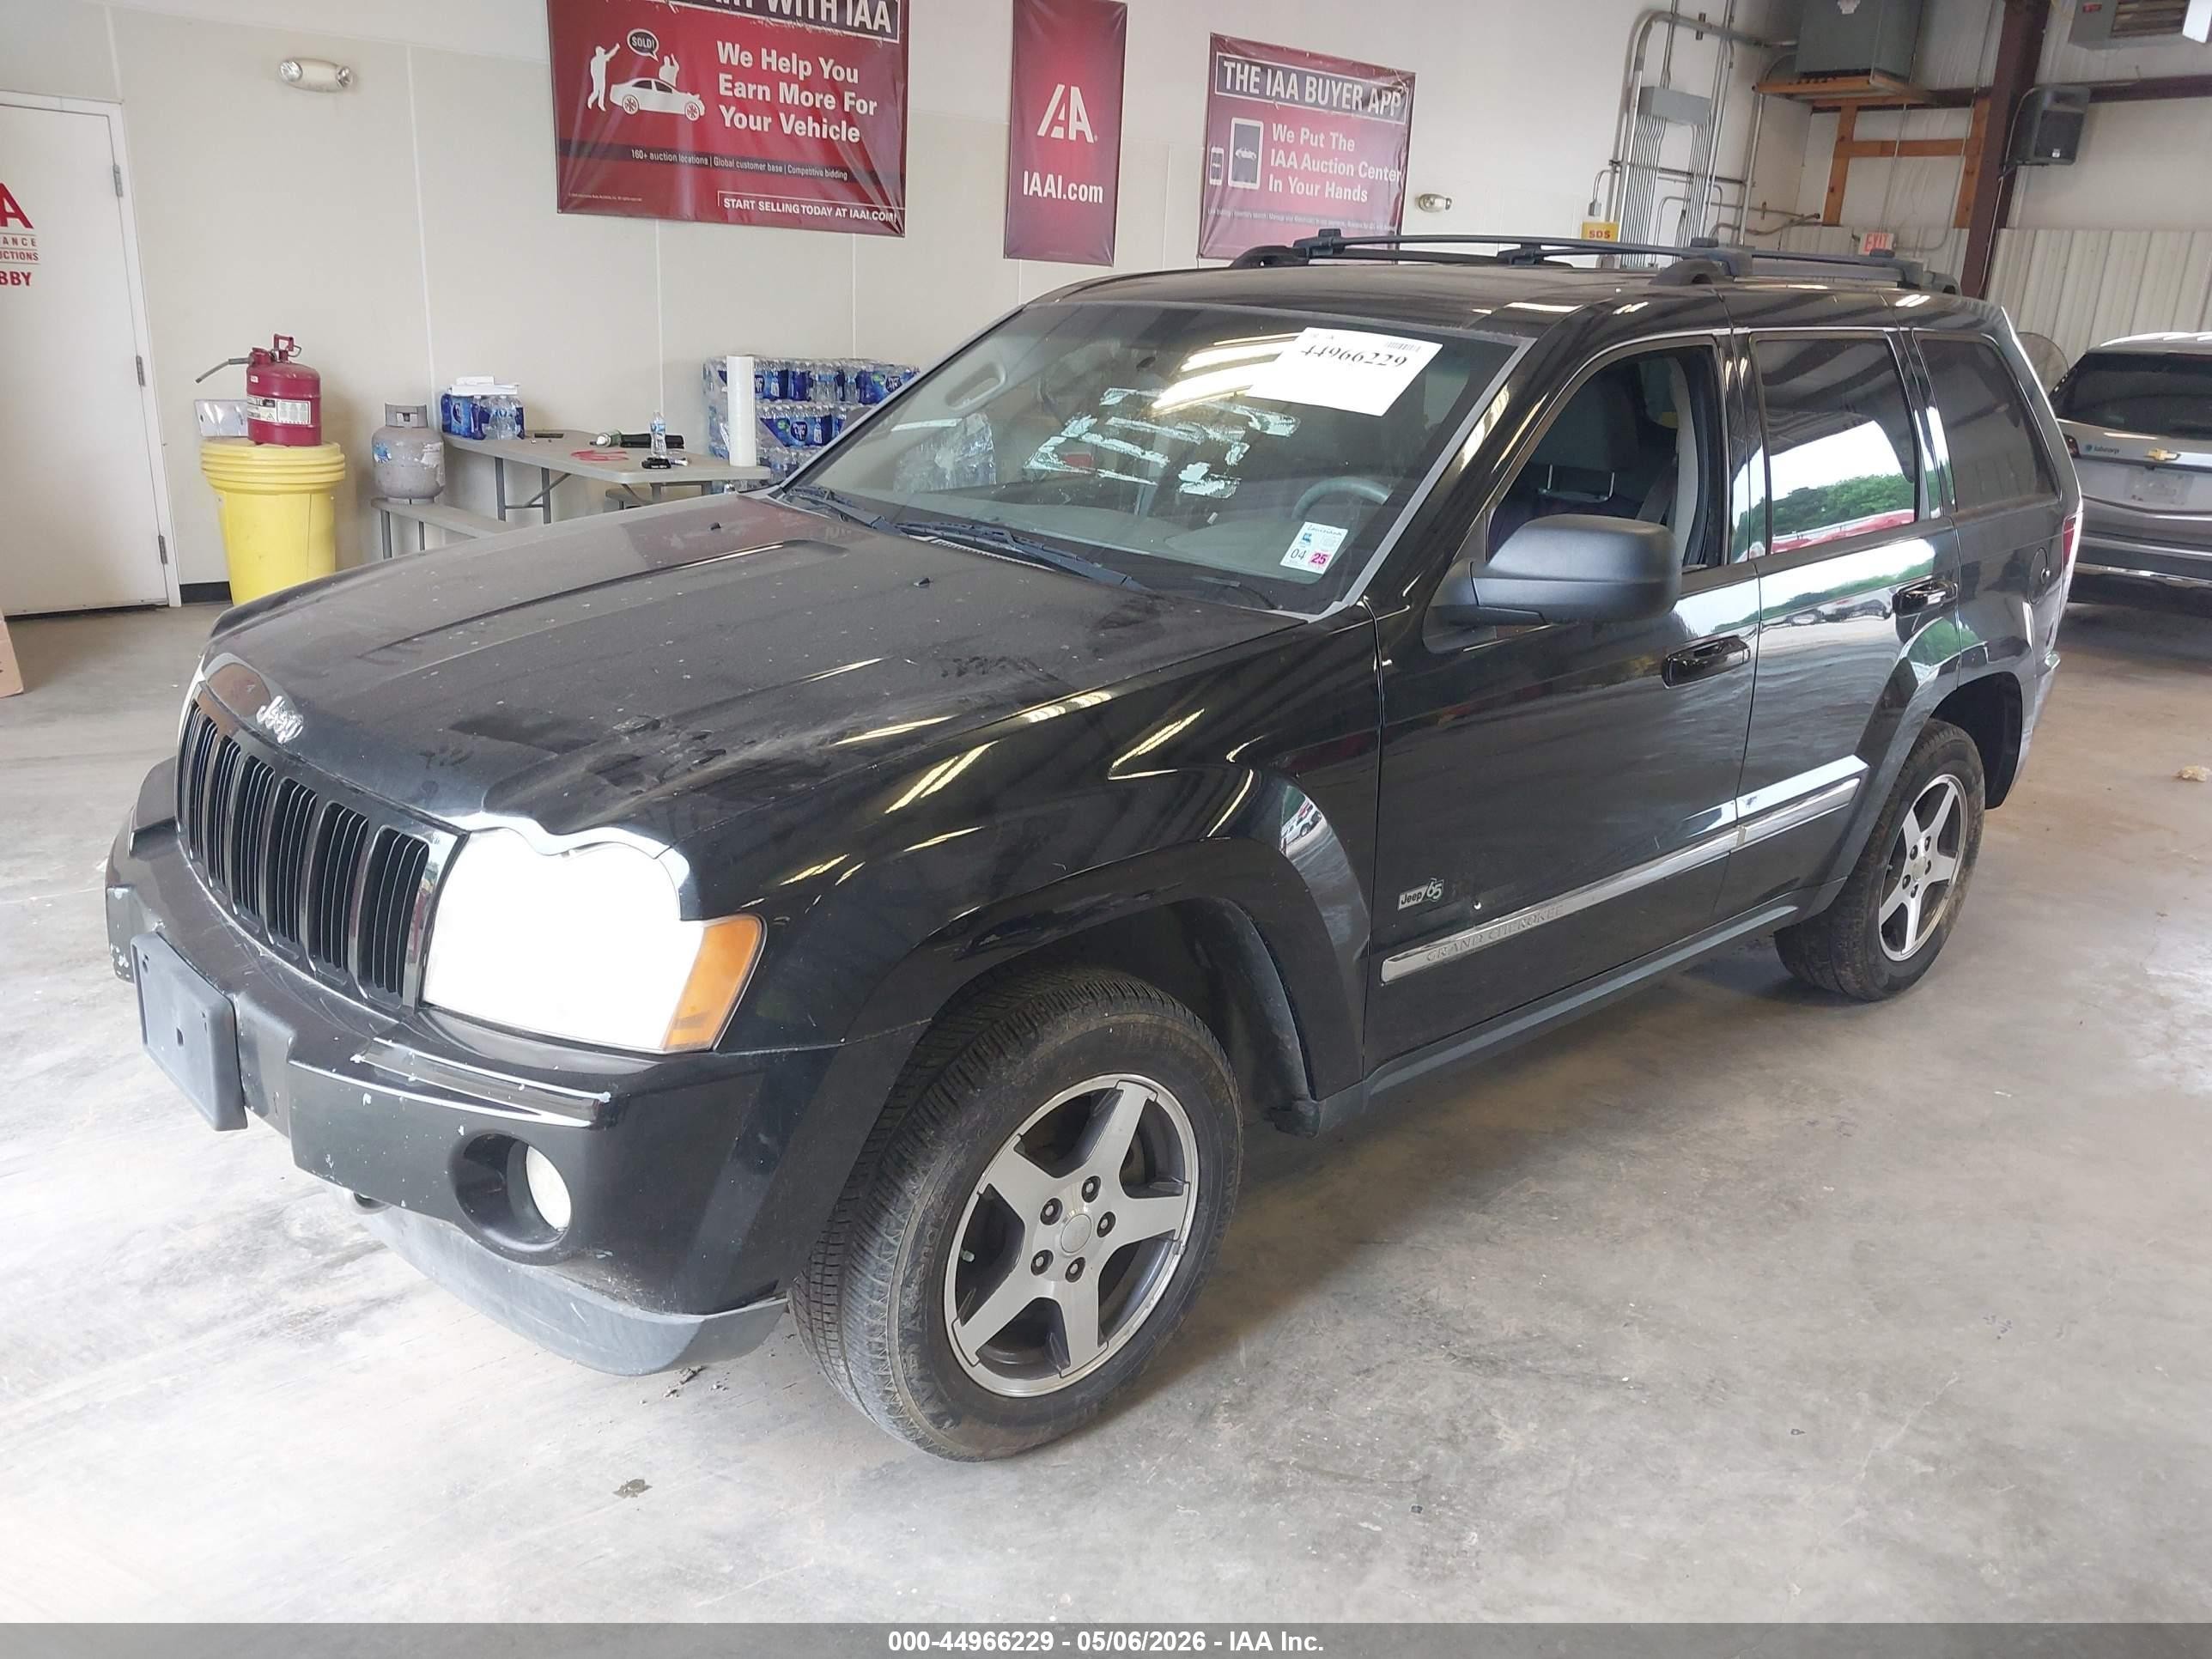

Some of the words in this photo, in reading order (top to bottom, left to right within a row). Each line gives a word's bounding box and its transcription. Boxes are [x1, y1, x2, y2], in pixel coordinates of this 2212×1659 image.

[846, 0, 891, 33] IAA
[717, 41, 753, 67] We
[761, 48, 811, 81] Help
[818, 57, 859, 83] You
[719, 73, 771, 101] Earn
[779, 82, 836, 110] More
[844, 91, 877, 115] For
[1224, 60, 1261, 94] THE
[1267, 70, 1298, 100] IAA
[1304, 76, 1363, 111] BUYER
[1367, 88, 1401, 116] APP
[719, 105, 772, 131] Your
[779, 112, 860, 143] Vehicle
[1273, 123, 1295, 143] We
[1300, 127, 1325, 148] Put
[1331, 131, 1355, 152] The
[631, 149, 647, 159] 160+
[650, 152, 677, 162] auction
[679, 155, 708, 166] locations
[714, 156, 734, 168] Global
[736, 161, 765, 170] customer
[768, 162, 783, 173] base
[787, 165, 823, 178] Competitive
[824, 169, 848, 180] bidding
[1271, 149, 1297, 169] IAA
[1301, 153, 1354, 177] Auction
[1358, 161, 1401, 182] Center
[1023, 170, 1103, 204] IAAI.com
[1269, 173, 1282, 193] In
[1288, 176, 1321, 197] Your
[1325, 180, 1368, 203] Hands
[724, 198, 755, 210] START
[758, 201, 799, 214] SELLING
[801, 204, 832, 216] TODAY
[835, 208, 848, 218] AT
[1300, 345, 1407, 368] 44966229
[1291, 548, 1307, 560] 04
[1311, 552, 1328, 564] 25
[1401, 891, 1423, 904] Jeep
[1426, 880, 1443, 900] 65
